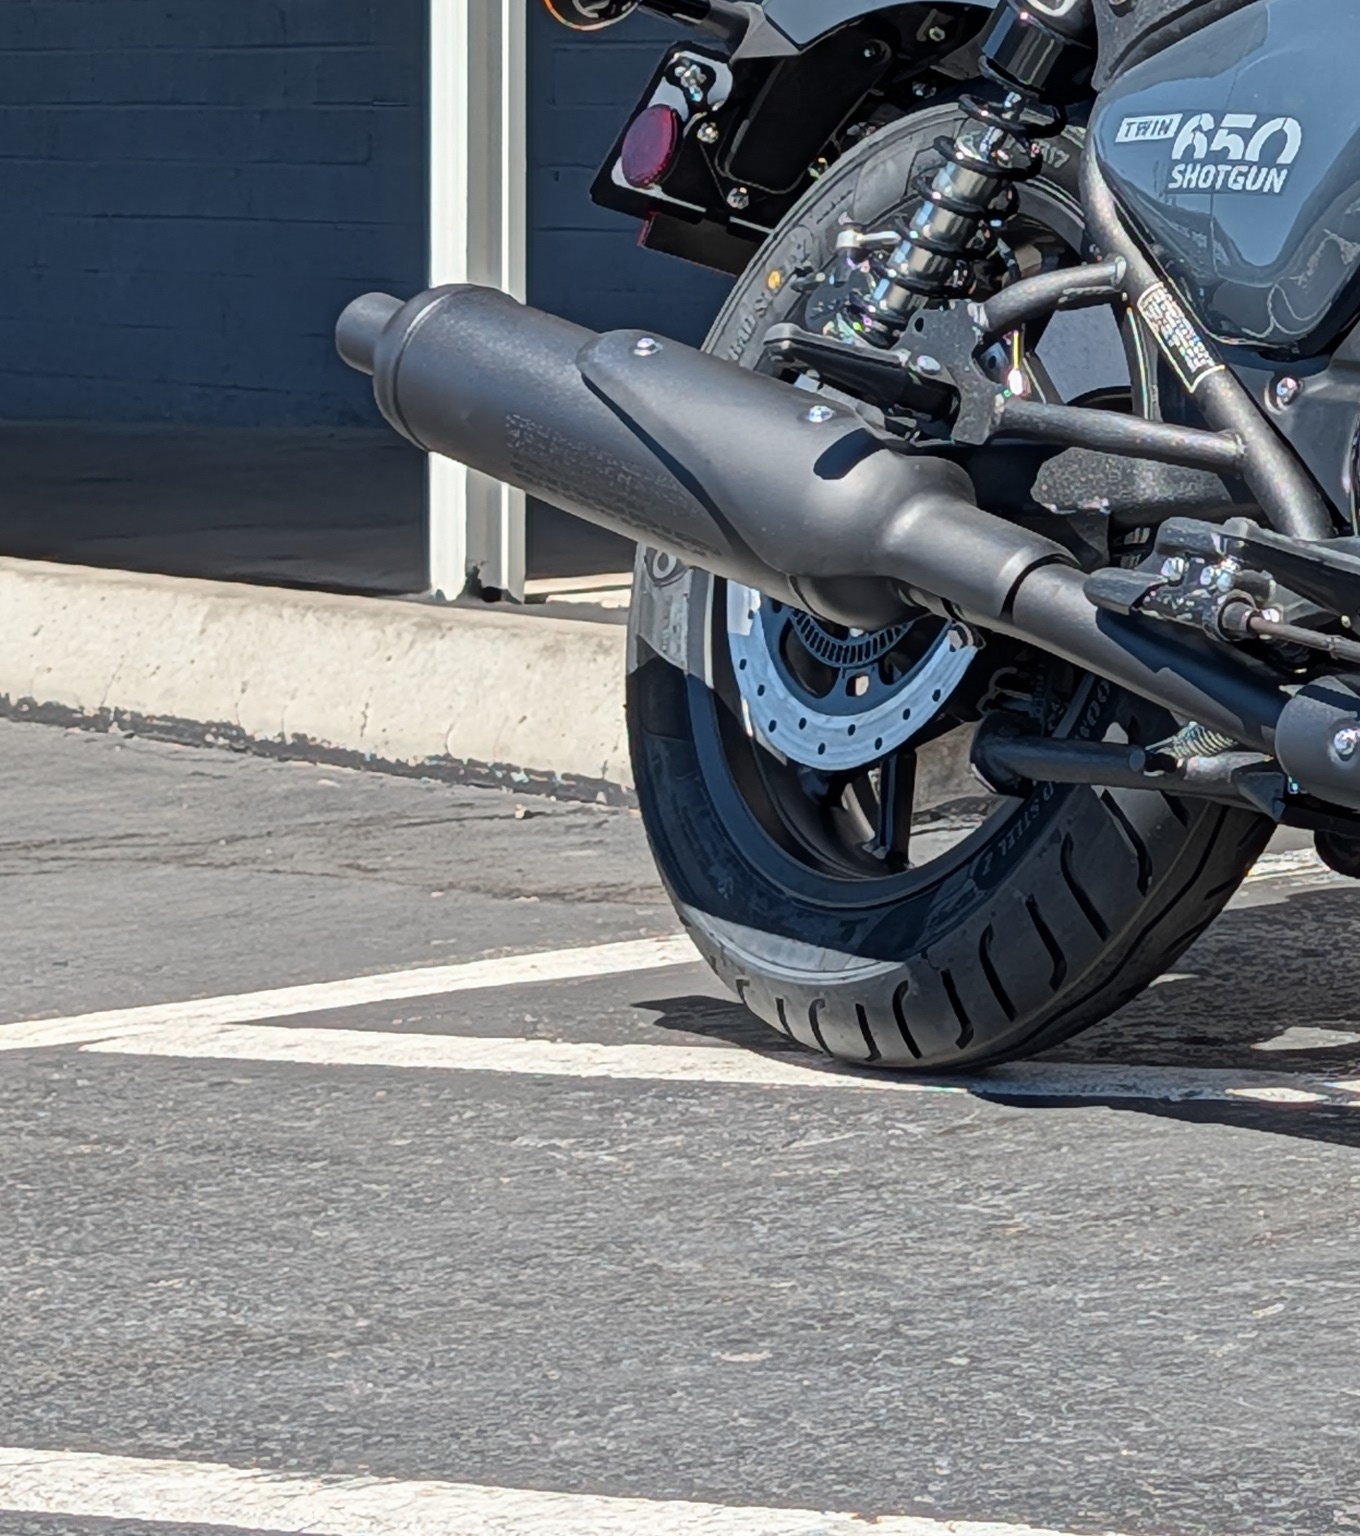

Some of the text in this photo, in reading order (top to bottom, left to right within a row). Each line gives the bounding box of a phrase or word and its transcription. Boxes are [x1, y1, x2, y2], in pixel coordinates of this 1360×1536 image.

[1121, 117, 1177, 139] TWIN
[1171, 112, 1303, 165] 650
[1168, 162, 1288, 194] SHOTGUN
